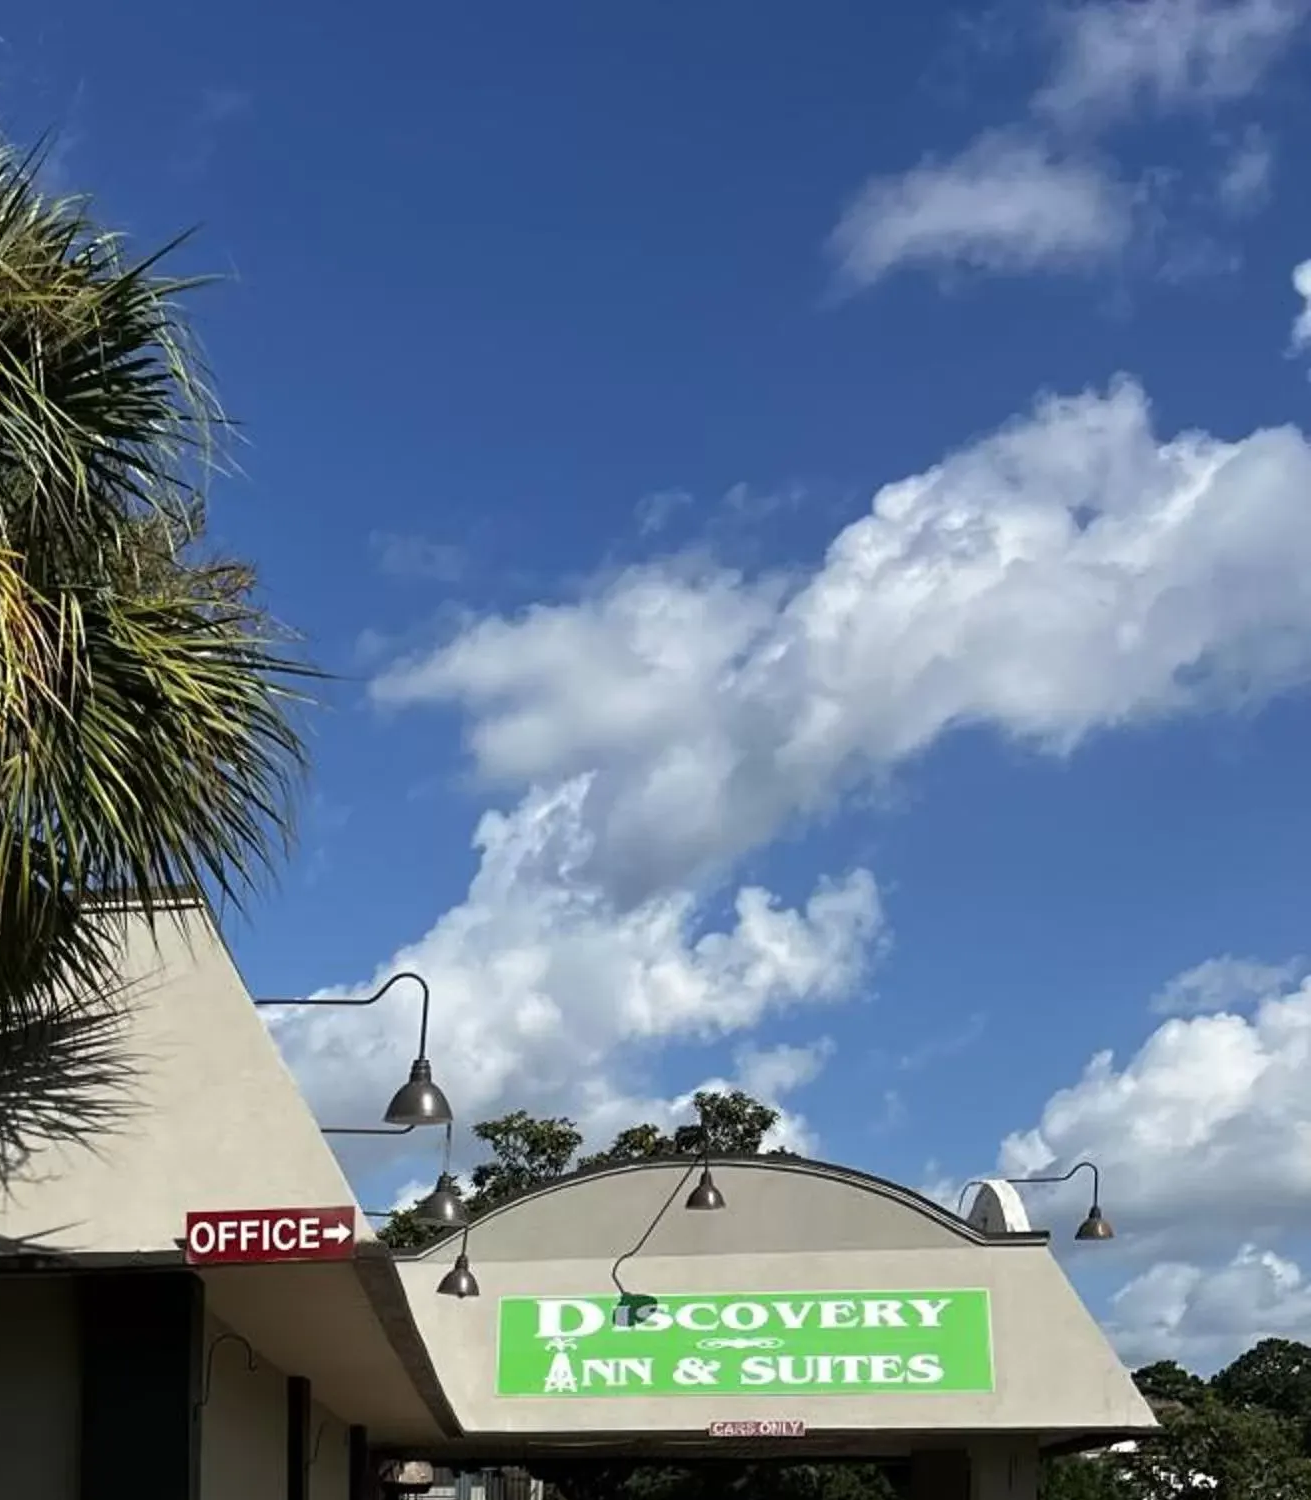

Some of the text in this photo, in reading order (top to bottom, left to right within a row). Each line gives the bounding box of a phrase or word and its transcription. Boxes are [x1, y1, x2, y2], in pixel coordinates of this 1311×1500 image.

[189, 1217, 321, 1254] OFFICE
[534, 1298, 953, 1338] DSCOVERY
[672, 1356, 722, 1386] &
[740, 1352, 946, 1386] SUITES
[712, 1421, 799, 1435] CARS ONLY
